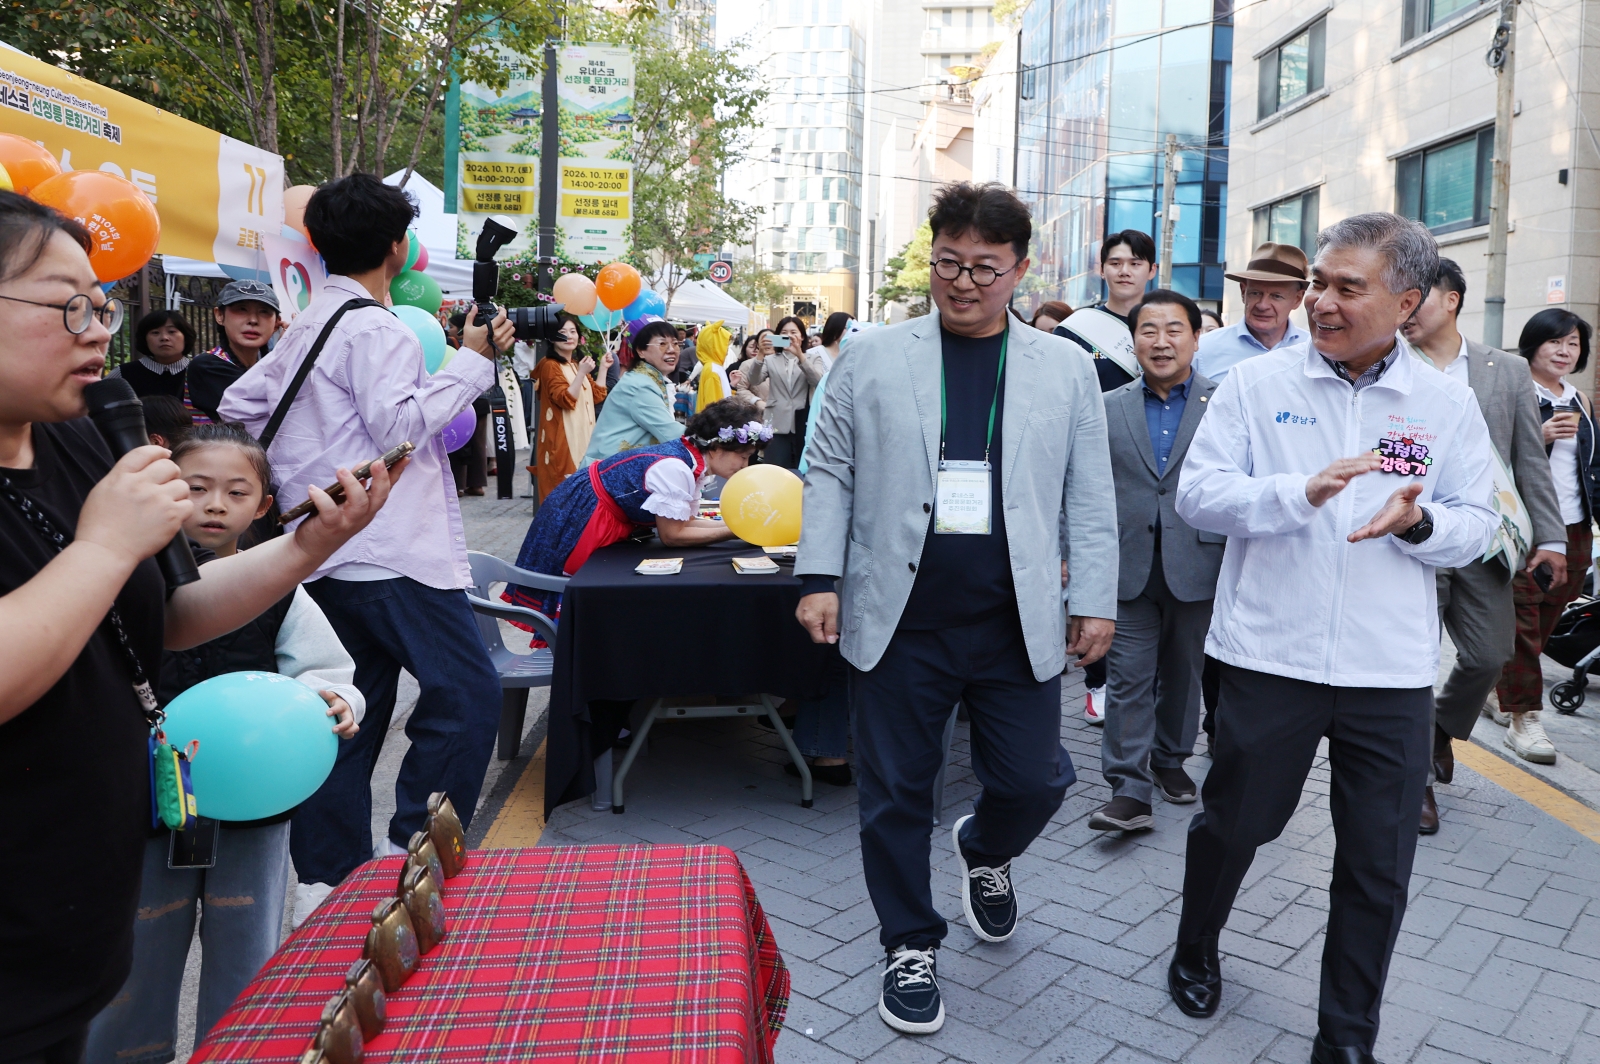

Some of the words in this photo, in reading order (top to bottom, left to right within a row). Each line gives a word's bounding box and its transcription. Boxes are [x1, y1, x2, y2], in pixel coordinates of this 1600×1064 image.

[579, 66, 615, 77] 유네스코
[564, 75, 591, 85] 선정릉
[594, 76, 629, 86] 문화거리
[588, 85, 606, 94] 축제
[51, 88, 72, 105] Cultural
[72, 96, 88, 110] Street
[87, 102, 107, 117] Festival
[32, 97, 63, 123] 선정릉
[64, 107, 101, 137] 문화거리
[103, 122, 121, 143] 축제
[466, 163, 490, 172] 2026.
[505, 166, 516, 174] 17.
[518, 166, 532, 174] (토)
[473, 174, 525, 183] 14:00-20:00
[563, 169, 588, 178] 2026.
[590, 171, 601, 179] 10.
[615, 172, 628, 180] (토)
[571, 180, 622, 189] 14:00-20:00
[476, 192, 501, 202] 선정릉
[503, 194, 521, 202] 일대
[574, 198, 600, 208] 선정릉
[602, 199, 618, 208] 일대
[573, 208, 600, 216] (봉은사로
[92, 213, 120, 240] 제104회
[713, 266, 727, 277] 30
[1291, 414, 1317, 426] 강남구
[495, 416, 507, 452] SONY
[1380, 439, 1429, 461] 구청장
[1380, 454, 1427, 475] 김현기
